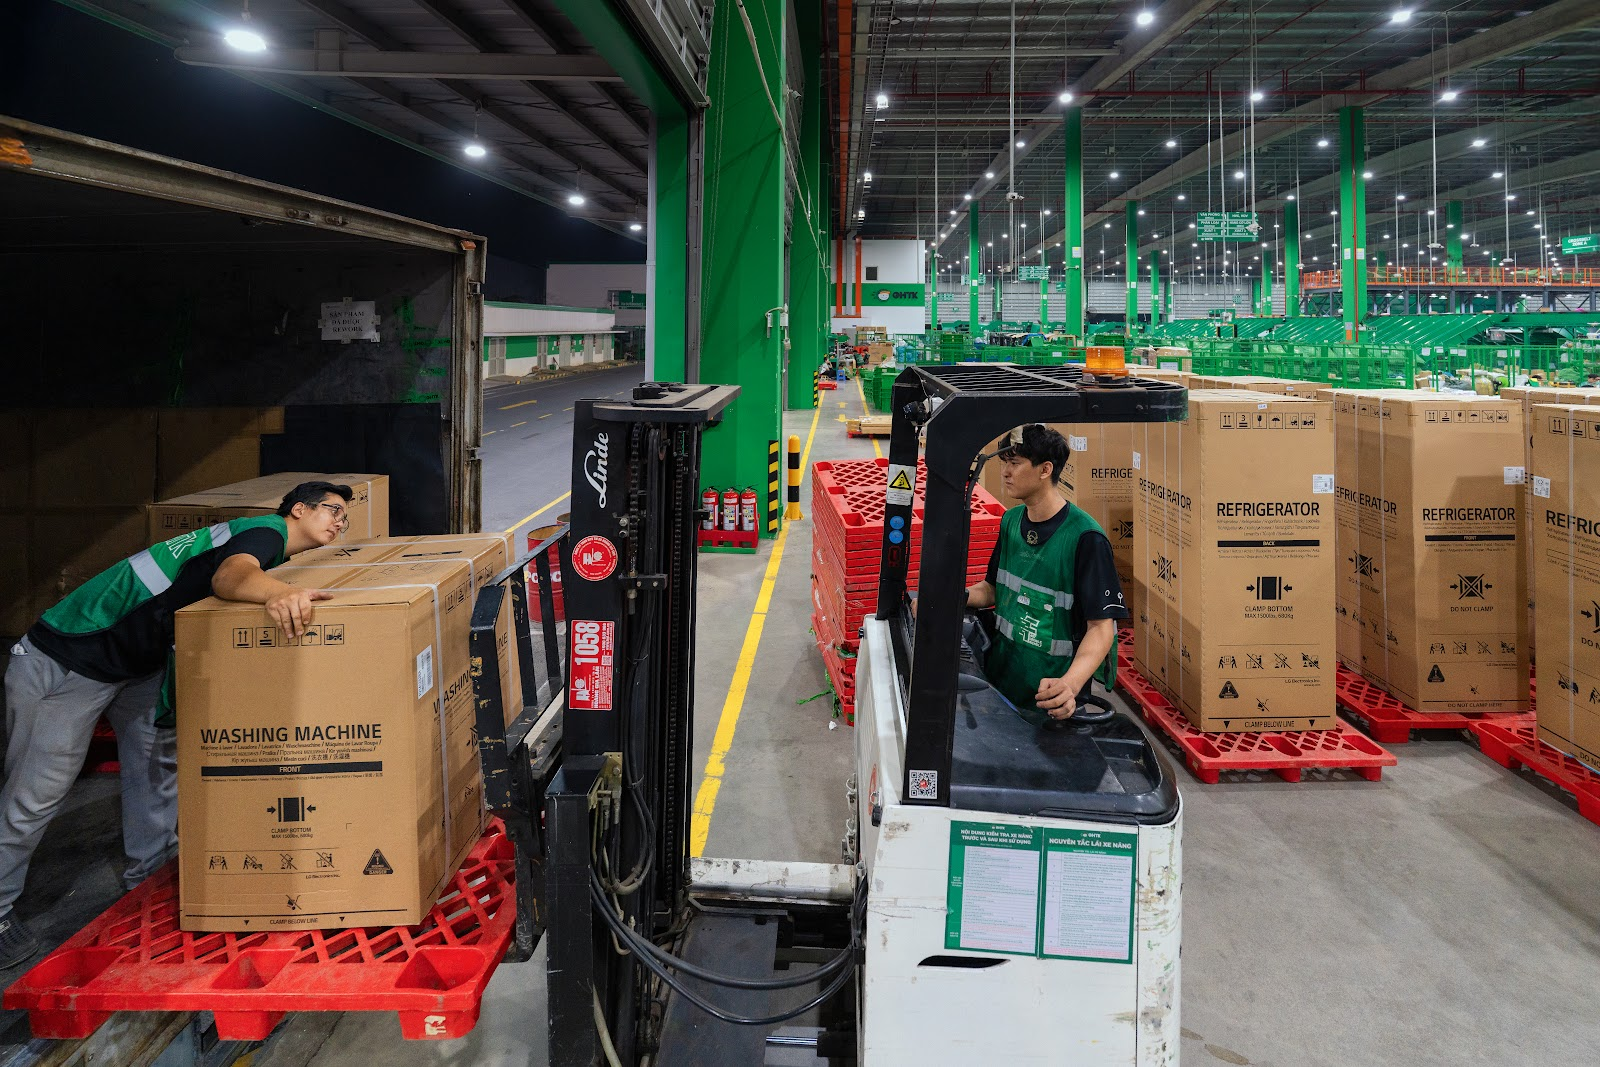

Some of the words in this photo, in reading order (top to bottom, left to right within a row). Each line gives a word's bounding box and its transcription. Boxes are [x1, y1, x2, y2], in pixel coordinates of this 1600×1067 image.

[584, 432, 608, 508] Linde
[1217, 502, 1319, 516] REFRIGERATOR
[1423, 507, 1515, 520] REFRIGERATOR
[575, 622, 600, 665] 1058
[201, 727, 288, 743] WASHING
[295, 724, 382, 741] MACHINE
